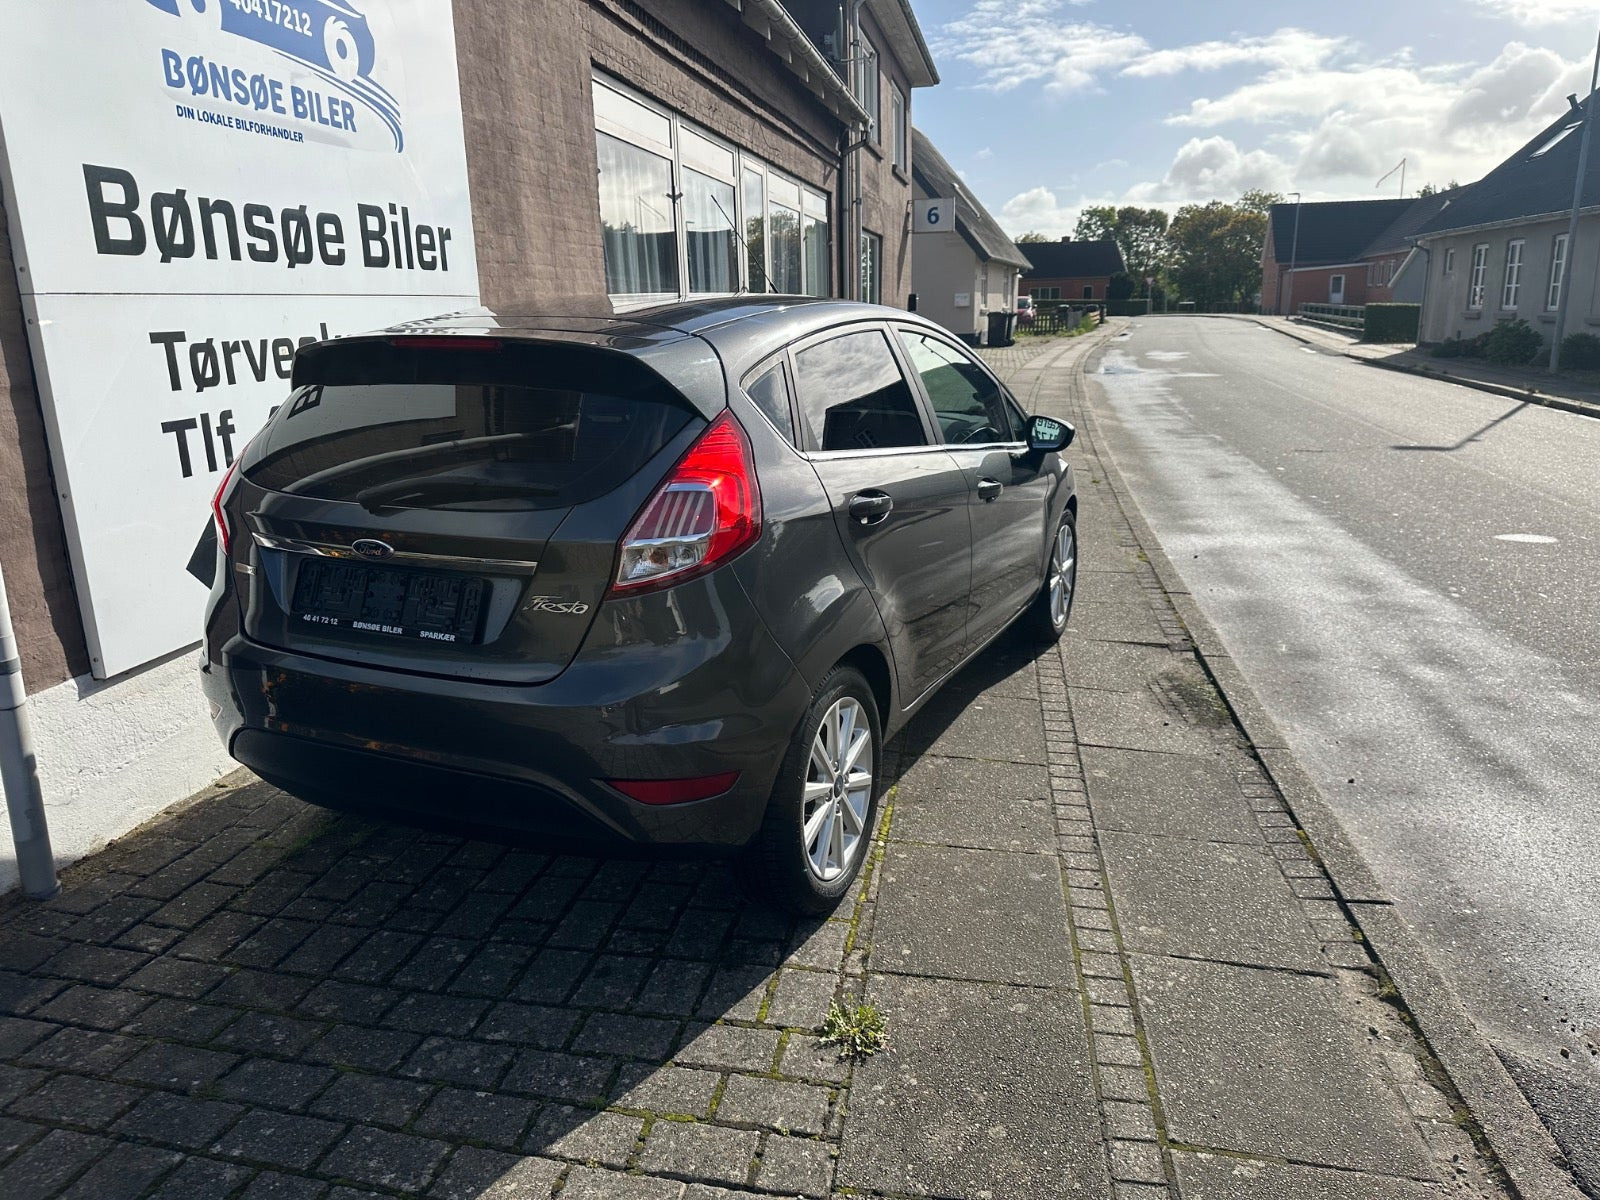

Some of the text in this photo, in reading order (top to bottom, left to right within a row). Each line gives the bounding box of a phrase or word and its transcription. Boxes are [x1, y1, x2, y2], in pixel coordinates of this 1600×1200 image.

[161, 48, 357, 133] BØNSØE BILER
[176, 104, 304, 143] DIN LOKALE BILFORHANDLER
[82, 163, 452, 271] Bønsøe Biler
[927, 206, 940, 225] 6
[522, 595, 589, 614] Fiesta
[302, 613, 311, 622] 40
[312, 615, 320, 623] 41
[321, 616, 329, 624] 72
[352, 620, 381, 632] BØNSØE
[382, 625, 403, 635] BILER
[419, 630, 456, 642] SPARKÆR
